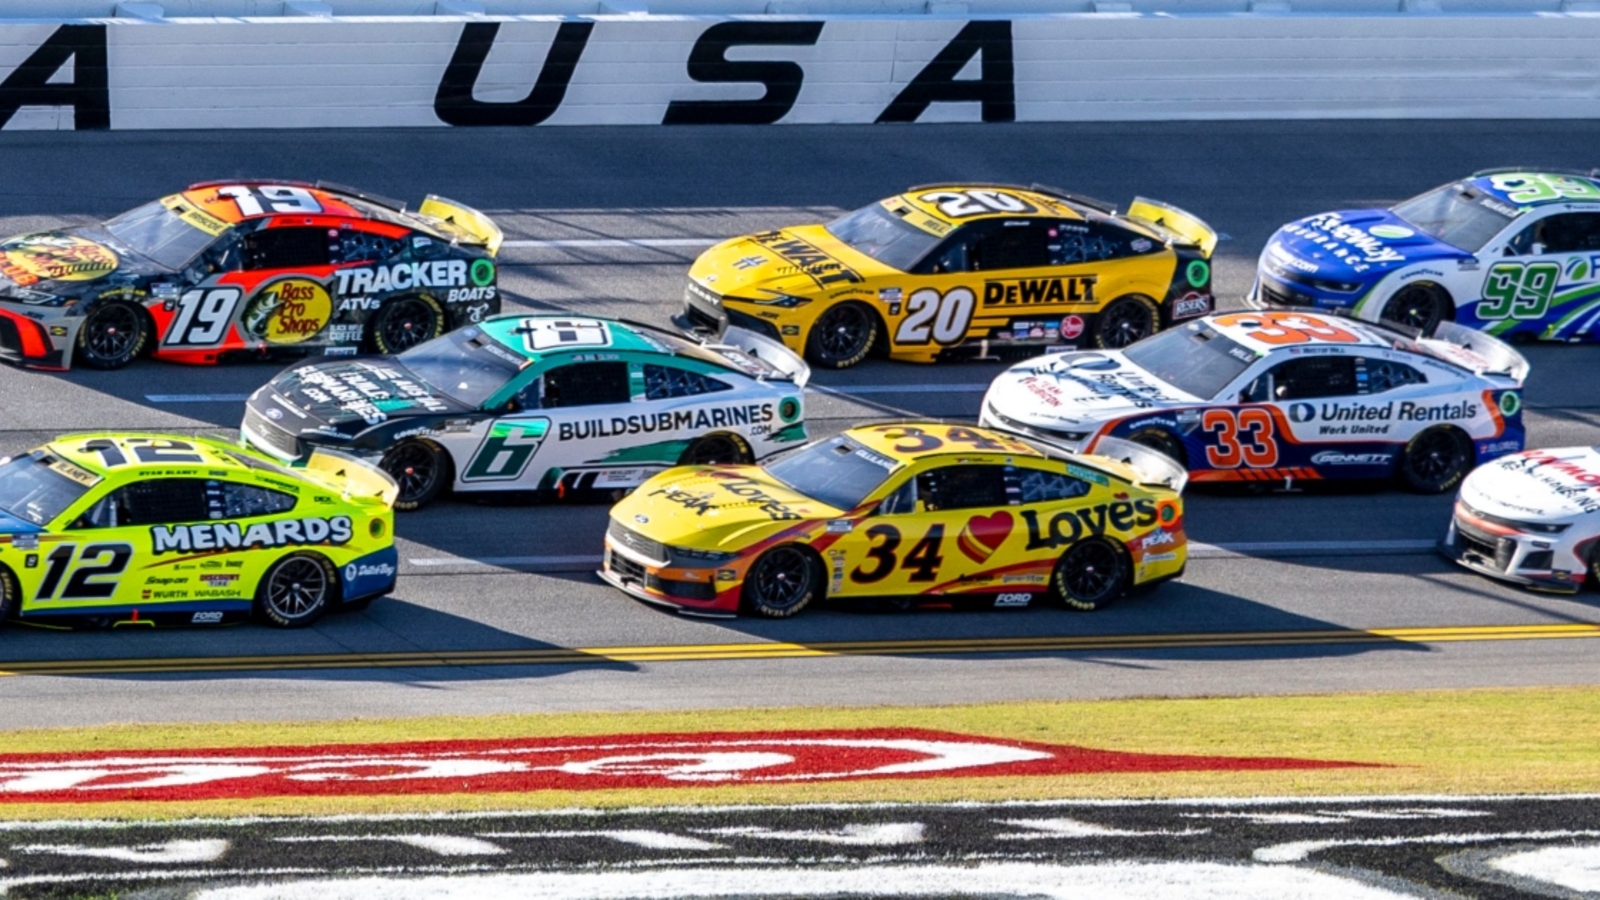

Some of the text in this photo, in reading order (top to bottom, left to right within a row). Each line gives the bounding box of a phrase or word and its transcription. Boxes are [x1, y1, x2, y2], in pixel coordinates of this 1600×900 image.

[217, 185, 324, 217] 19
[919, 190, 1029, 217] 20
[188, 211, 223, 231] BRISCOE
[922, 218, 946, 234] BELL
[335, 259, 467, 294] TRACKER
[280, 282, 315, 300] Bass
[447, 286, 496, 303] BOATS
[1476, 261, 1562, 319] 99
[278, 300, 306, 316] Pro
[338, 297, 381, 311] ATVs
[166, 288, 241, 346] 19
[276, 316, 320, 335] Shops
[894, 286, 976, 346] 20
[329, 332, 363, 341] COFFEE
[1213, 311, 1360, 345] 33
[1228, 346, 1252, 363] HILL
[1321, 400, 1477, 422] United Rentals
[558, 403, 773, 441] BUILDSUBMARINES
[749, 425, 772, 437] .COM
[1319, 424, 1389, 435] Work United
[873, 426, 1006, 453] 34
[1202, 408, 1278, 468] 33
[85, 438, 202, 468] 12
[463, 418, 549, 481] 6
[1320, 453, 1393, 463] BENNETT
[57, 462, 92, 482] BLANEY
[648, 489, 721, 516] PEAK
[151, 516, 353, 556] MENARDS
[1142, 532, 1175, 549] PEAK
[850, 523, 946, 584] 34
[34, 542, 133, 601] 12
[144, 575, 189, 586] Snap-on
[995, 593, 1032, 604] FORD
[192, 611, 223, 621] FORD
